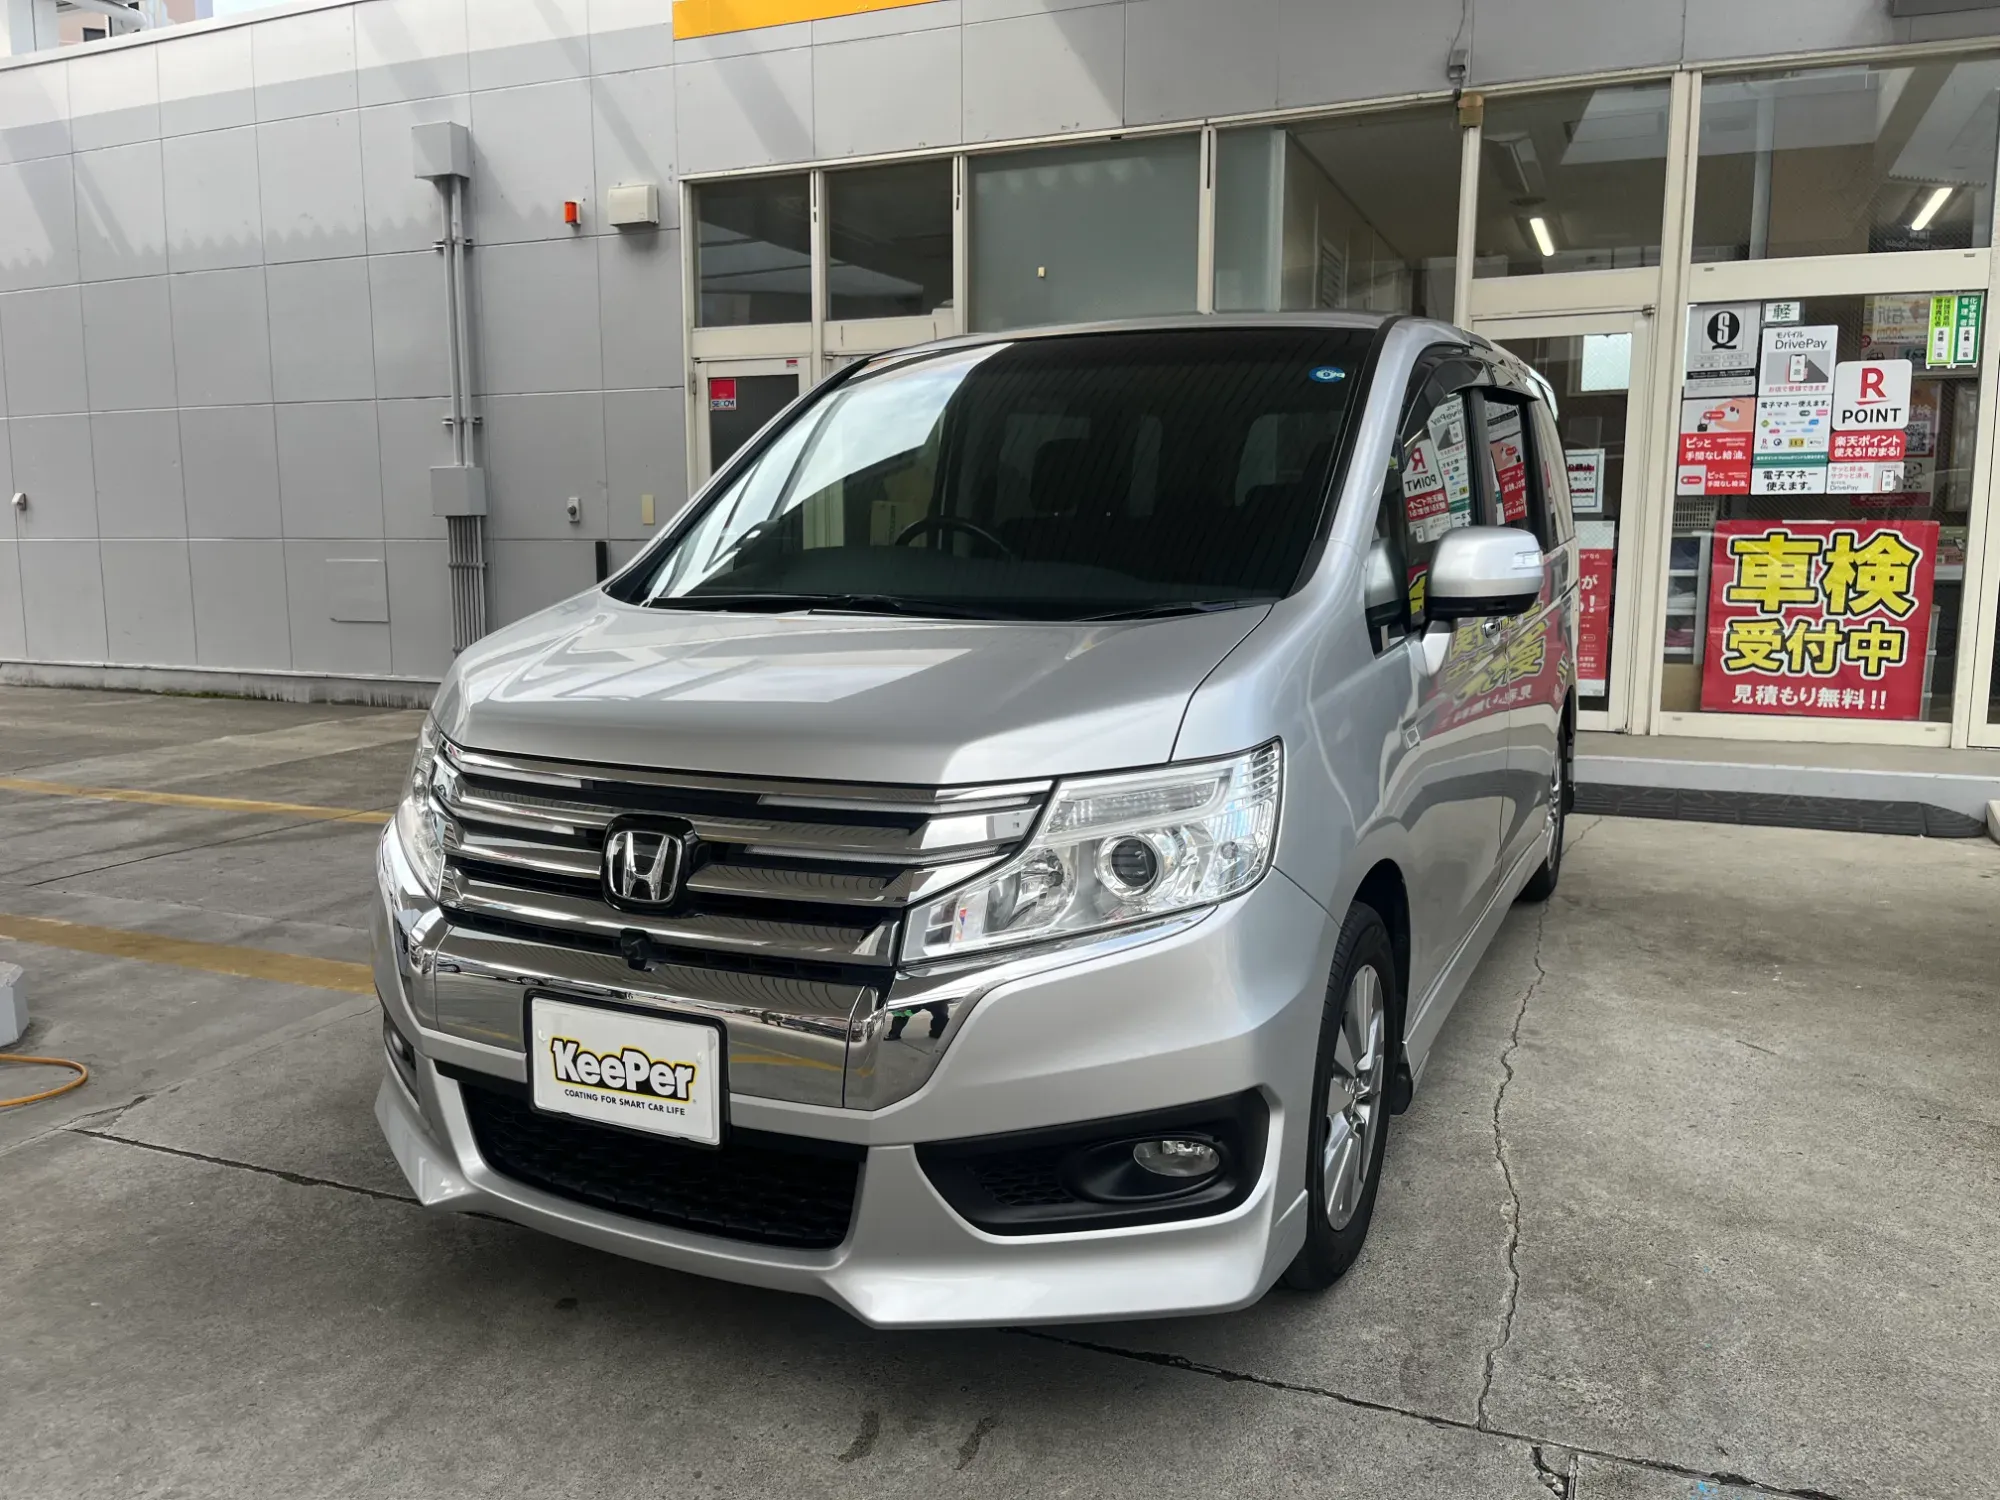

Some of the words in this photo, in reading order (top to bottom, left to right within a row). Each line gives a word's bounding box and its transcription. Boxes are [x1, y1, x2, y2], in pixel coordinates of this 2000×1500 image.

[1772, 304, 1792, 320] 軽
[1775, 338, 1828, 350] DrivePay
[1860, 367, 1886, 398] R
[1760, 400, 1830, 409] 電子マネー使えます。
[1842, 408, 1902, 424] POINT
[1686, 436, 1712, 448] ピッと
[1834, 434, 1900, 448] 楽天ポイント
[1685, 450, 1746, 462] 手間なし給油。
[1762, 470, 1818, 480] 電子マネー
[1766, 481, 1812, 492] 使えます。
[1726, 531, 1921, 617] 車検
[1723, 619, 1906, 677] 受付中
[1732, 684, 1888, 710] 見積もり無料!!
[551, 1037, 696, 1102] KeePer
[564, 1088, 598, 1102] COATING
[601, 1095, 617, 1105] FOR
[619, 1098, 646, 1110] SMART
[648, 1102, 664, 1113] CAR
[666, 1106, 686, 1116] LIFE
